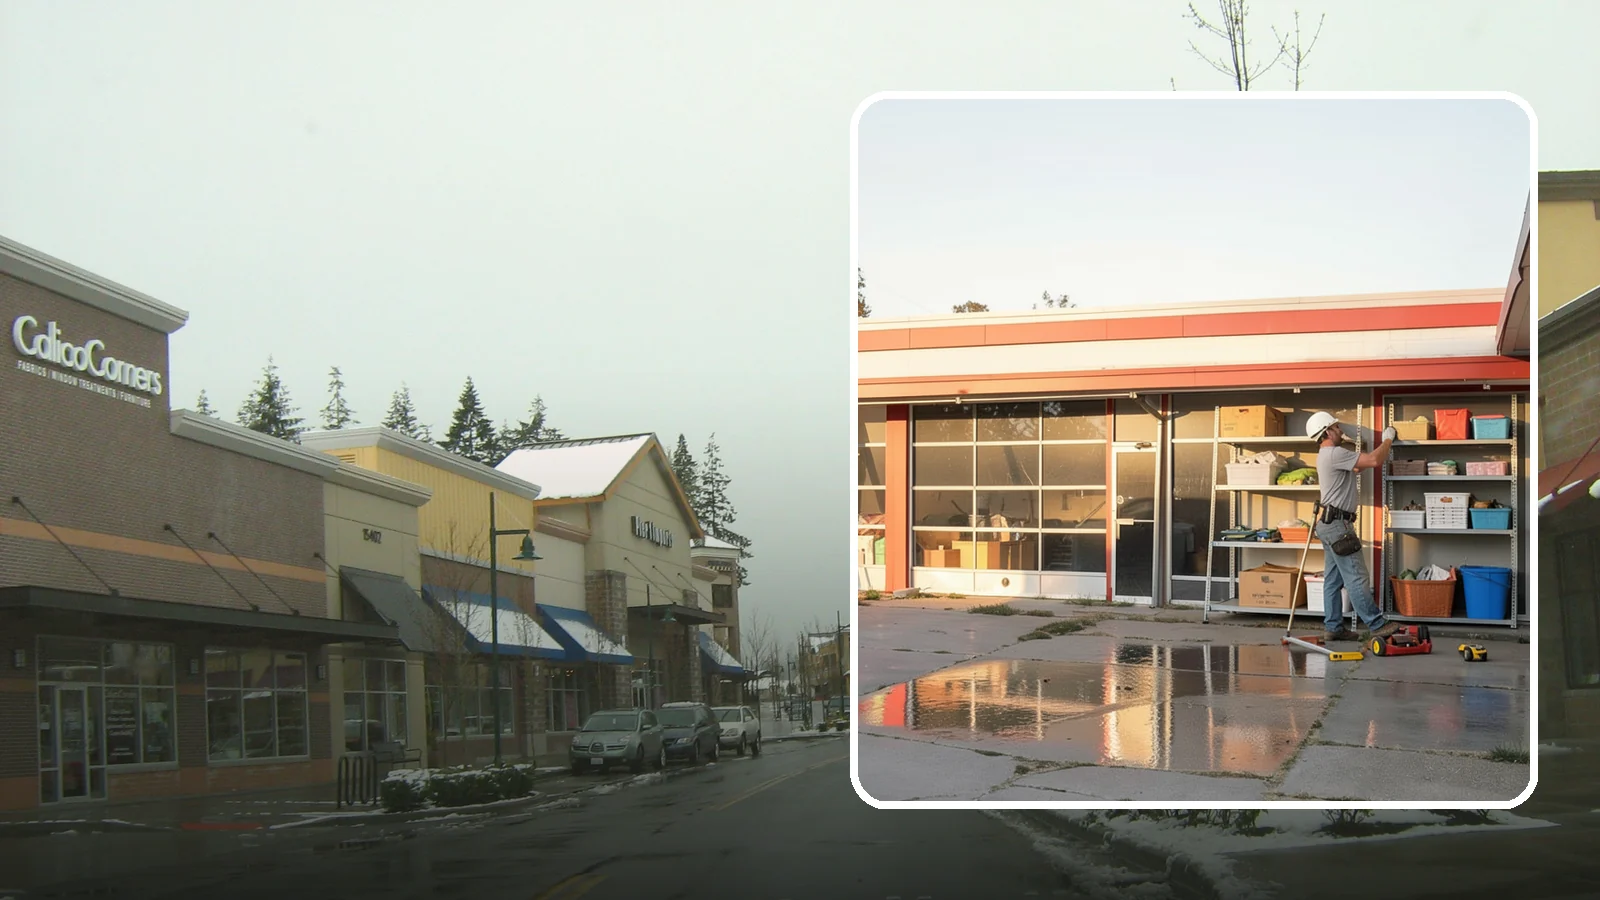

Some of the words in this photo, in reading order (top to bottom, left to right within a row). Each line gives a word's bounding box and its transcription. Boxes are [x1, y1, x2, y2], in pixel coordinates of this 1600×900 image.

[16, 360, 47, 377] FABRICS
[51, 370, 78, 386] WINDOW
[79, 379, 116, 398] TREATMENTS
[120, 391, 151, 408] FURNITURE
